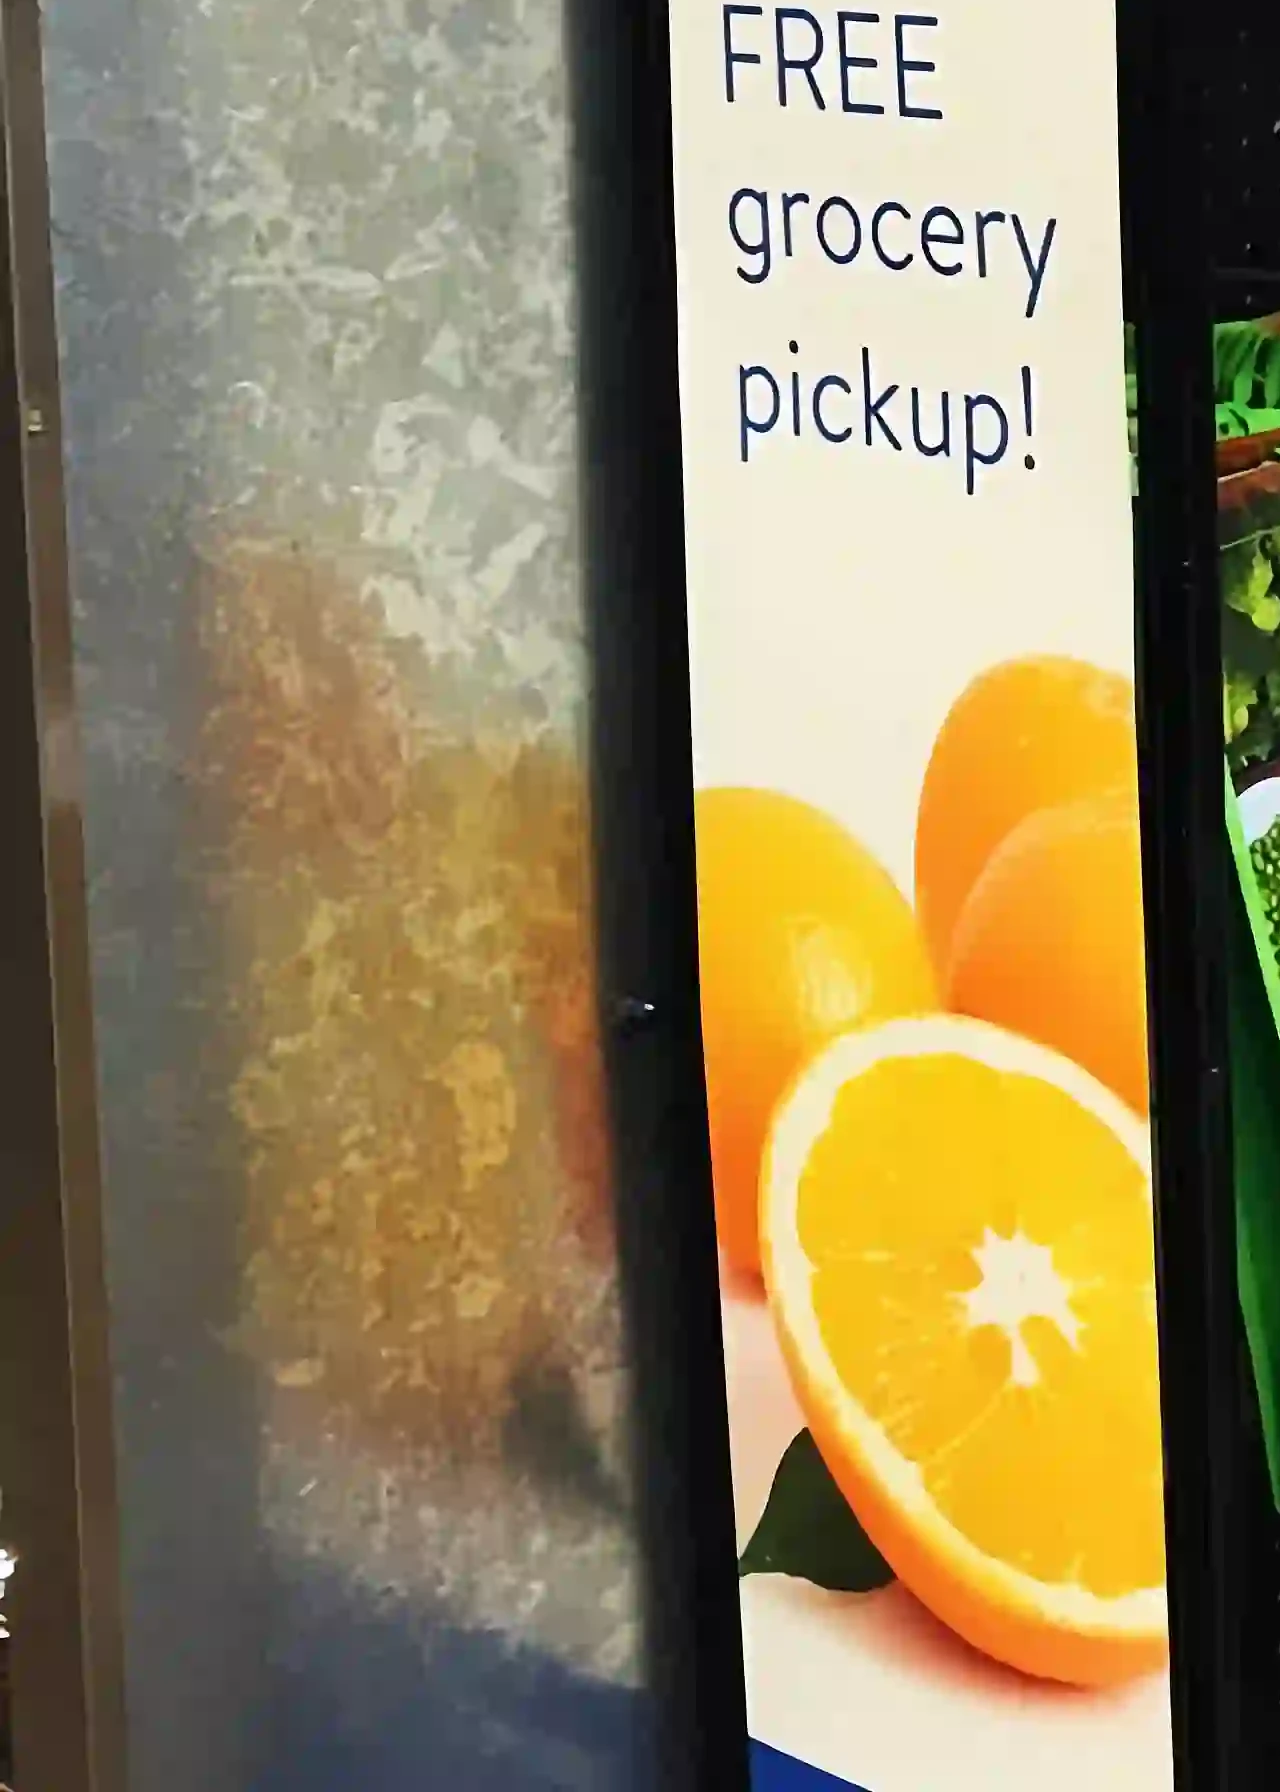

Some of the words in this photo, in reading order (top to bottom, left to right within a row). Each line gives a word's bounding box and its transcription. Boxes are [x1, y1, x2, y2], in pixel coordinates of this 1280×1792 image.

[722, 3, 943, 120] FREE
[728, 187, 1058, 318] grocery
[739, 339, 1036, 495] pickup!
